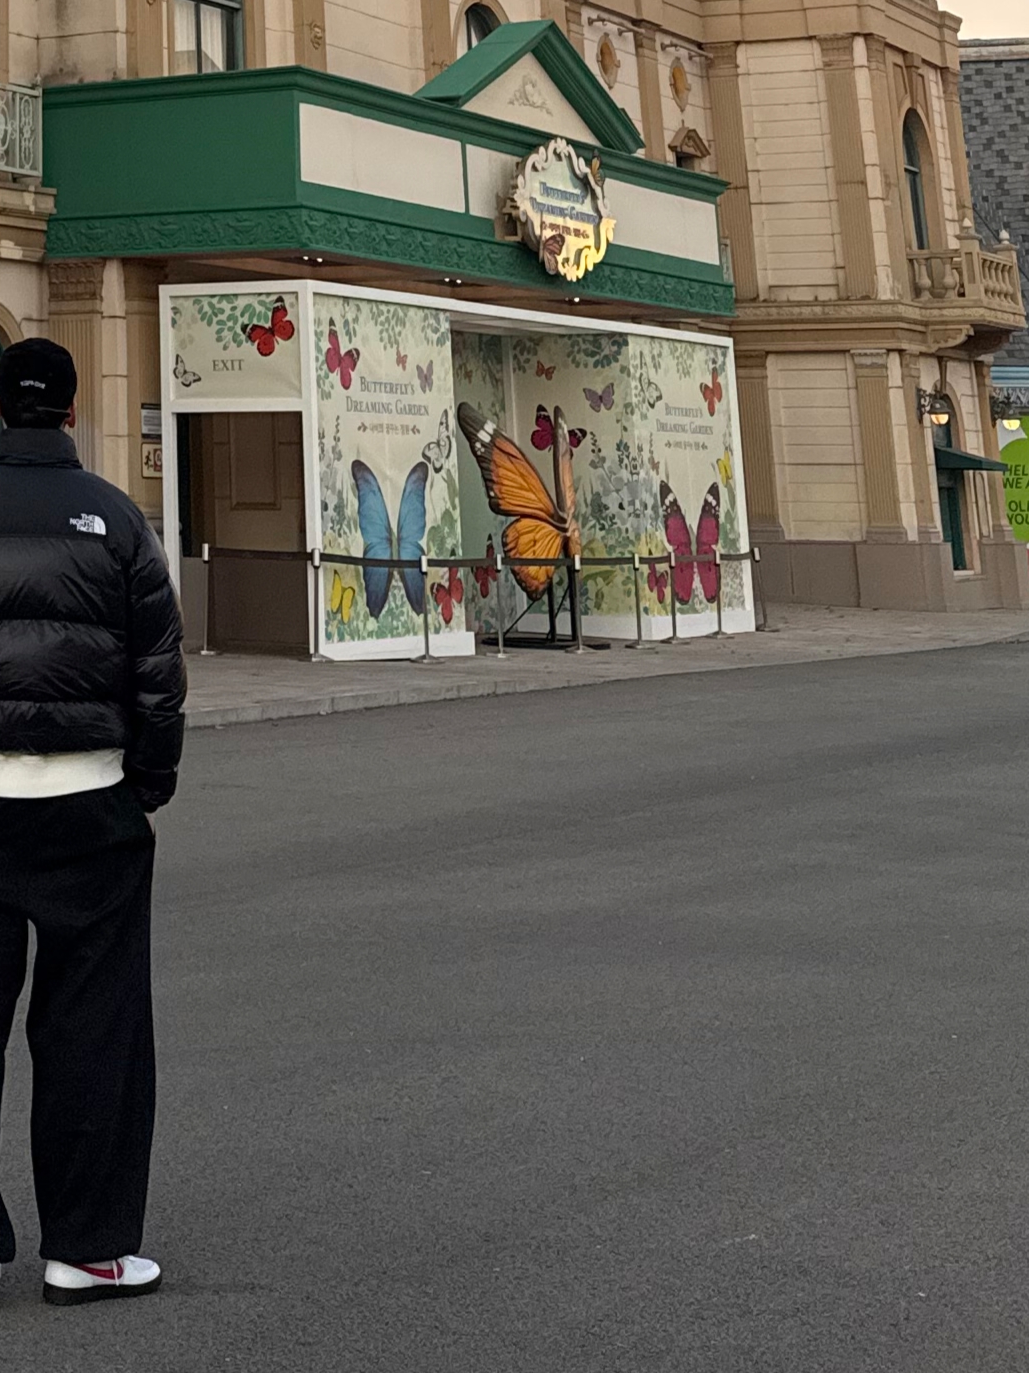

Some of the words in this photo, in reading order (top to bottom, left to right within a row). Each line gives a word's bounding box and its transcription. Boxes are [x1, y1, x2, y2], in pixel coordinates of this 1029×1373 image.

[212, 359, 245, 372] EXIT
[360, 376, 415, 395] BUTTERFLY'S
[346, 396, 393, 415] DREAMING
[395, 399, 430, 416] GARDEN
